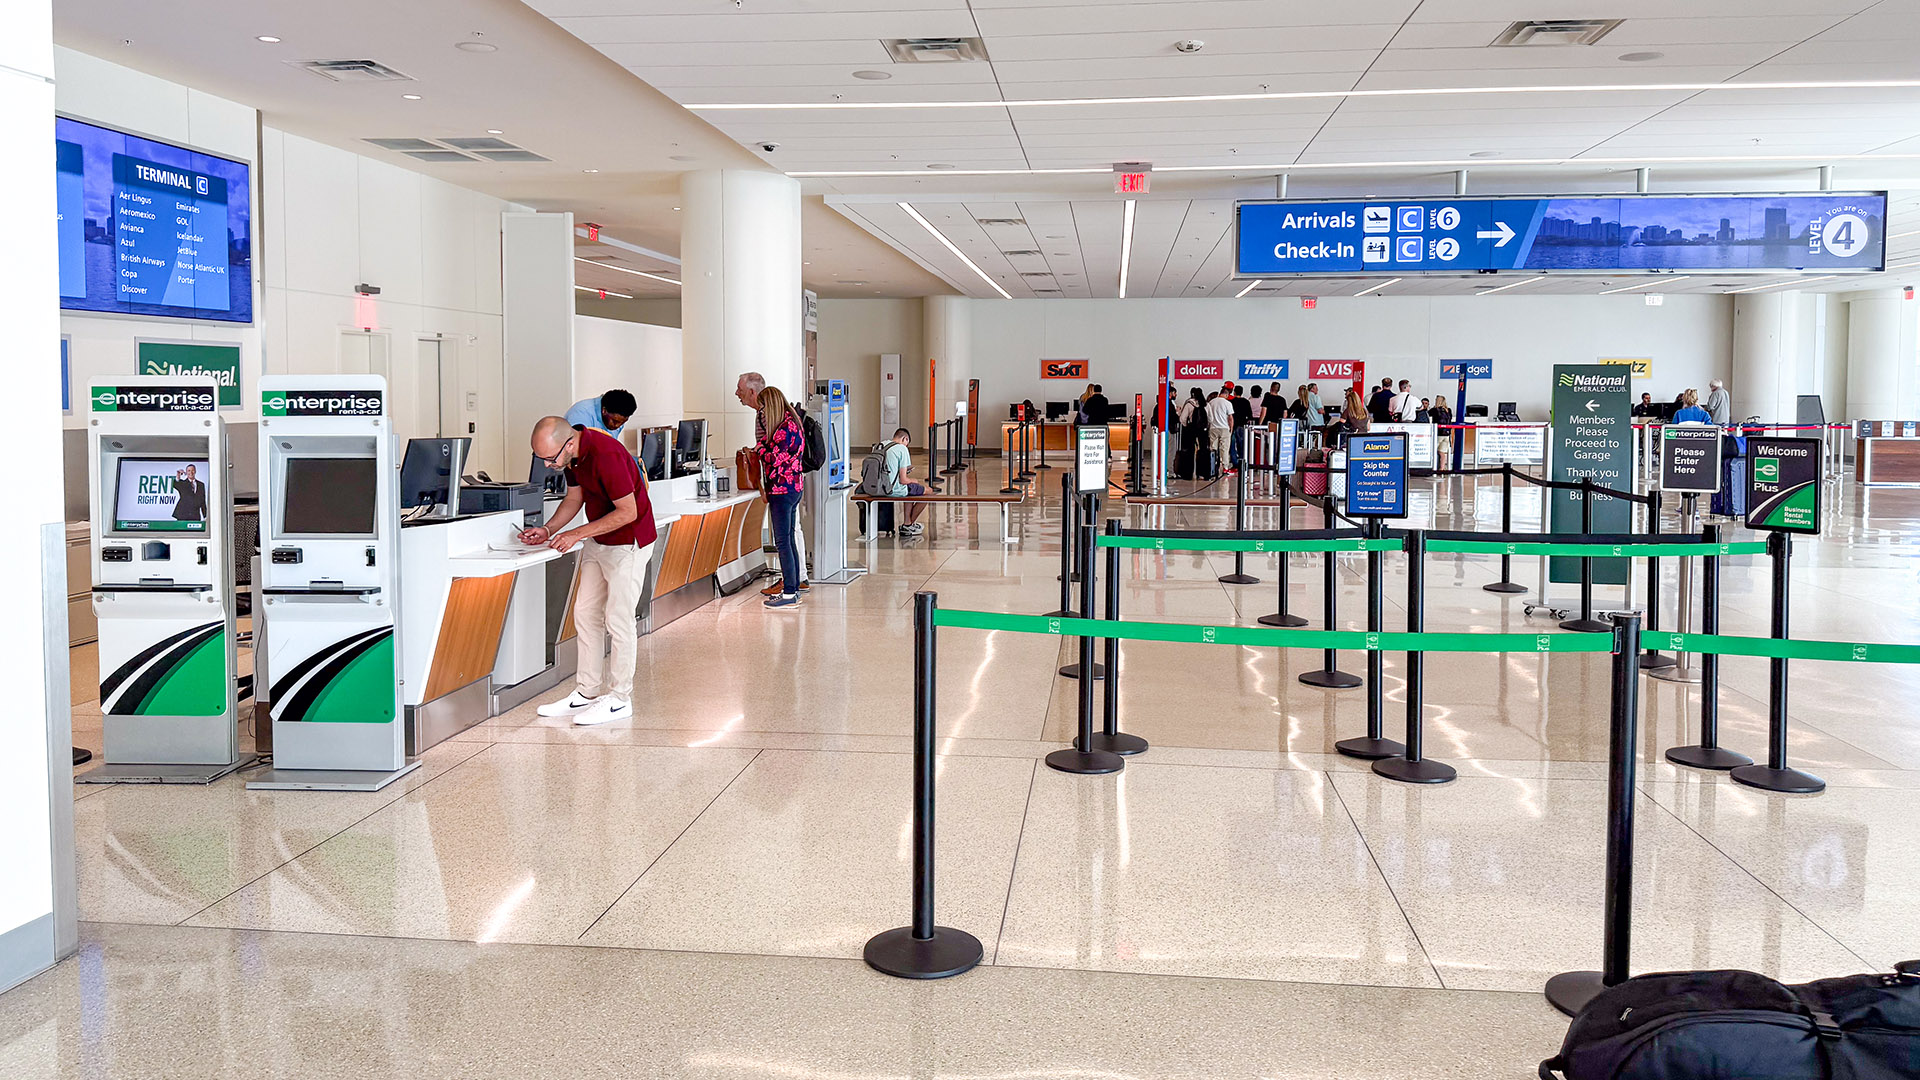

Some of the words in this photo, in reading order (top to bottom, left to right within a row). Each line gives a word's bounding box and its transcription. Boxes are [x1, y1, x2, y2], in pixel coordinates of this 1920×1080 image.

[136, 165, 191, 189] TERMINAL
[199, 180, 206, 191] C
[1121, 173, 1145, 192] EXIT
[119, 191, 130, 200] Aer
[132, 194, 151, 204] Lingus
[120, 207, 156, 220] Aeromexico
[176, 202, 200, 214] Emirates
[1826, 207, 1842, 216] You
[1857, 208, 1867, 217] on
[176, 217, 189, 226] GOL
[1282, 211, 1355, 229] Arrivals
[1402, 210, 1417, 228] C
[1443, 211, 1453, 226] 6
[120, 223, 144, 233] Avianca
[177, 232, 204, 243] Icelandair
[1809, 217, 1822, 255] LEVEL
[1831, 221, 1855, 250] 4
[121, 238, 135, 247] Azul
[177, 247, 197, 257] JetBlue
[1274, 241, 1355, 259] Check-In
[1401, 240, 1417, 258] C
[1442, 241, 1453, 257] 2
[121, 253, 140, 263] British
[142, 256, 165, 267] Airways
[177, 261, 194, 270] Norse
[195, 264, 216, 273] Atlantic
[216, 266, 225, 274] UK
[121, 269, 137, 279] Copa
[178, 276, 195, 284] Porter
[122, 284, 147, 294] Discover
[1047, 361, 1082, 376] SIXT
[1180, 364, 1218, 375] dollar.
[1244, 364, 1283, 378] Thrifty
[1316, 363, 1352, 376] AVIS
[1456, 365, 1489, 376] Bdget
[1573, 374, 1626, 386] National
[99, 390, 213, 408] enterprise
[269, 394, 381, 412] enterprise
[1569, 415, 1615, 424] Members
[1576, 427, 1608, 436] Please
[1668, 430, 1716, 438] enterprise
[1364, 443, 1390, 451] Alamo
[1565, 438, 1606, 448] Proceed
[1609, 439, 1620, 448] to
[1573, 450, 1611, 461] Garage
[1674, 448, 1705, 456] Please
[1757, 445, 1808, 457] Welcome
[1363, 462, 1377, 470] Skip
[1674, 457, 1699, 465] Enter
[1566, 467, 1597, 477] Thank
[1599, 469, 1619, 479] you
[1674, 466, 1696, 474] Here
[139, 475, 177, 494] RENT
[1754, 482, 1779, 492] Plus
[137, 495, 158, 504] RIGHT
[159, 495, 177, 505] NOW
[1570, 491, 1613, 501] Buness
[1784, 506, 1812, 514] Business
